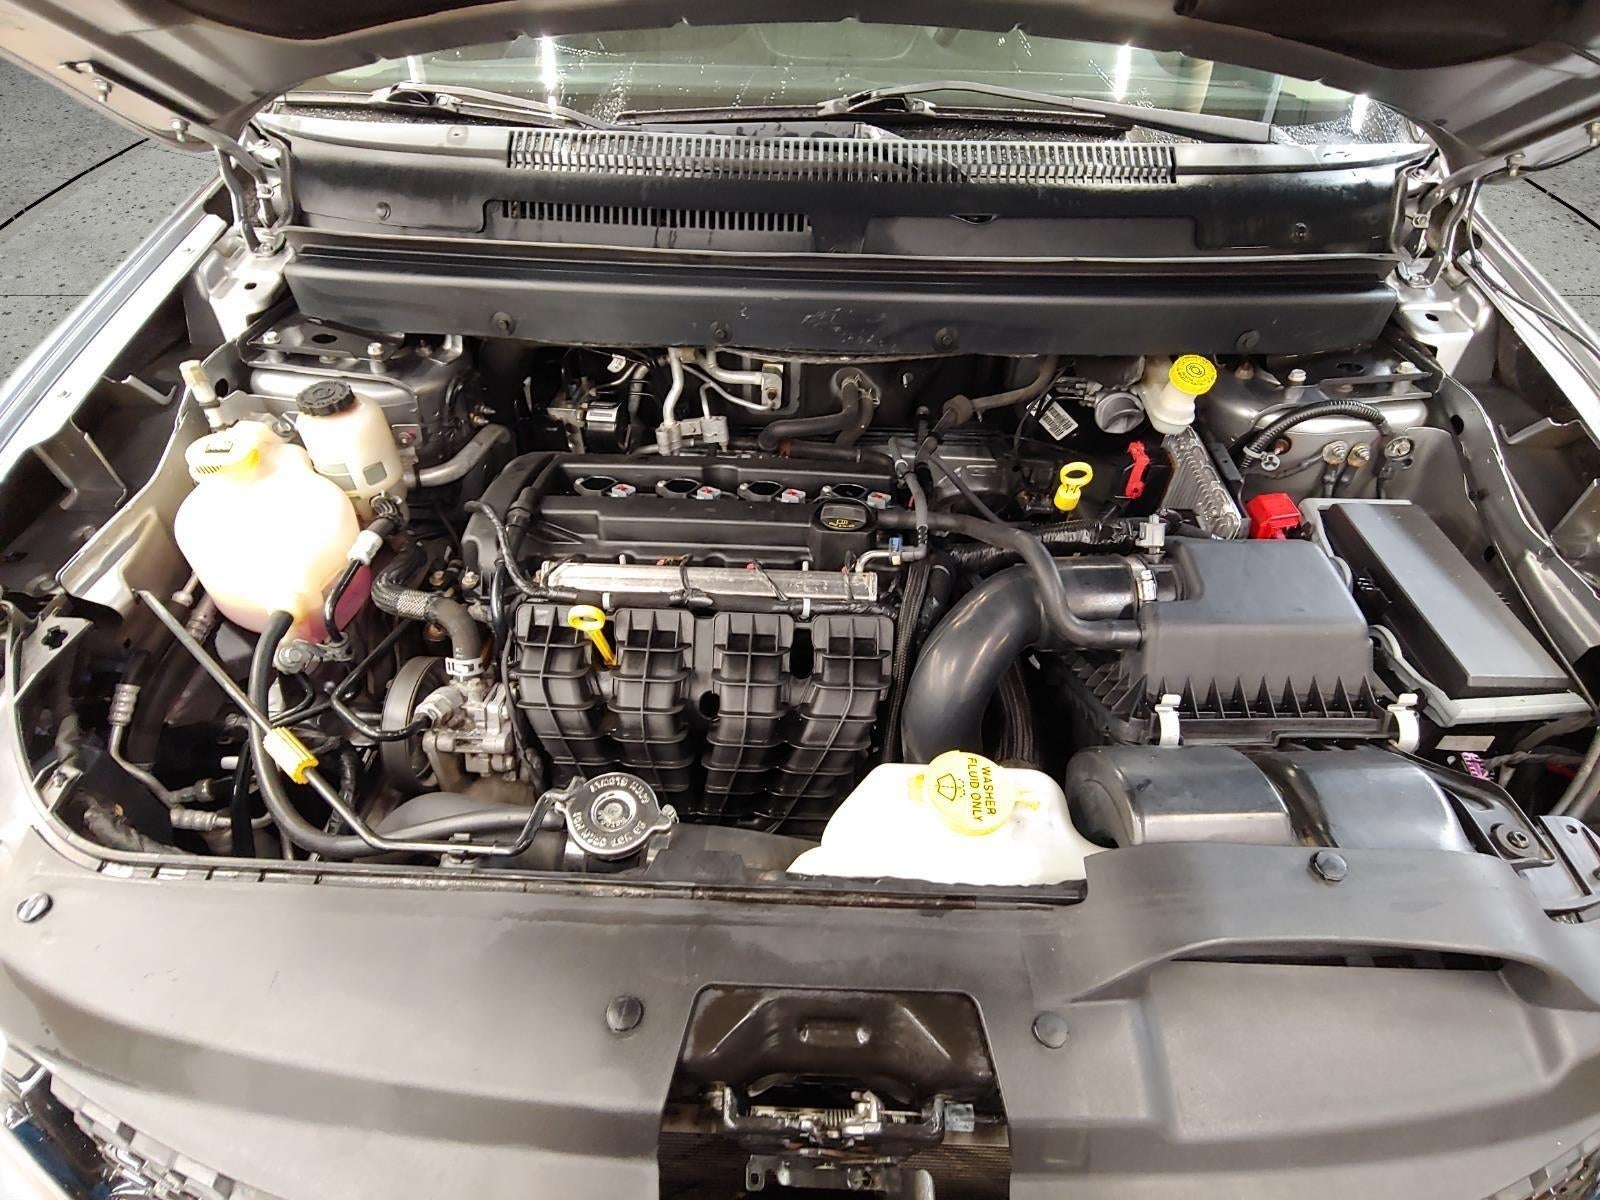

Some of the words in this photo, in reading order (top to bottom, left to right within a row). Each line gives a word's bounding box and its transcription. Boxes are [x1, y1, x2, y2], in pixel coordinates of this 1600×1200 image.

[968, 757, 980, 789] FLUID
[982, 766, 996, 815] WASHER
[971, 792, 983, 822] ONLY
